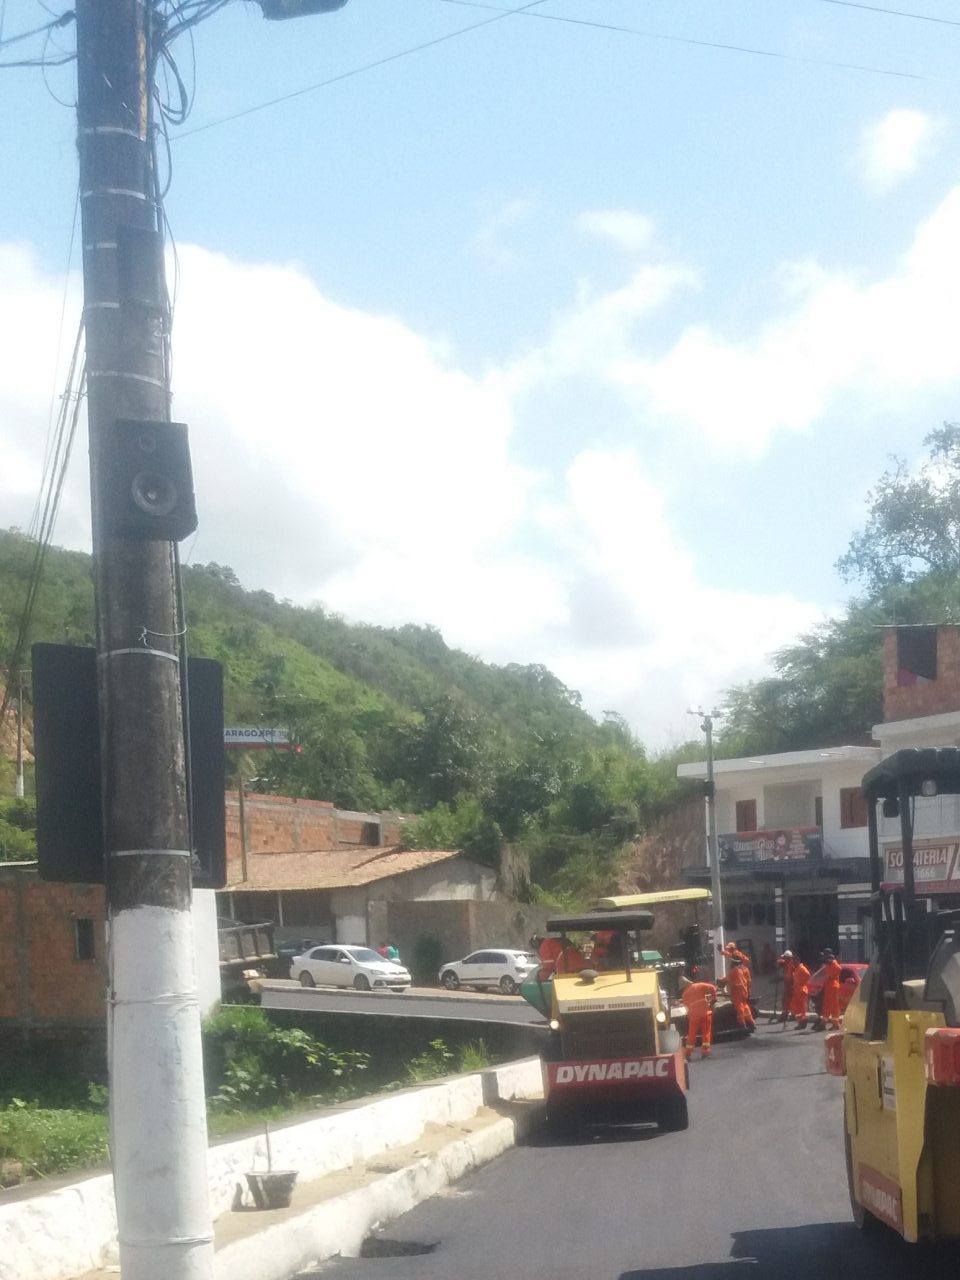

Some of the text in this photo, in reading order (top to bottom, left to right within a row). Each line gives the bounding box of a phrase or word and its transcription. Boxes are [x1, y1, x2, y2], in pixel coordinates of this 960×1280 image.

[225, 729, 277, 737] ARAGOJIPE
[912, 848, 947, 866] ATERIA
[556, 1059, 669, 1083] DYNAPAC
